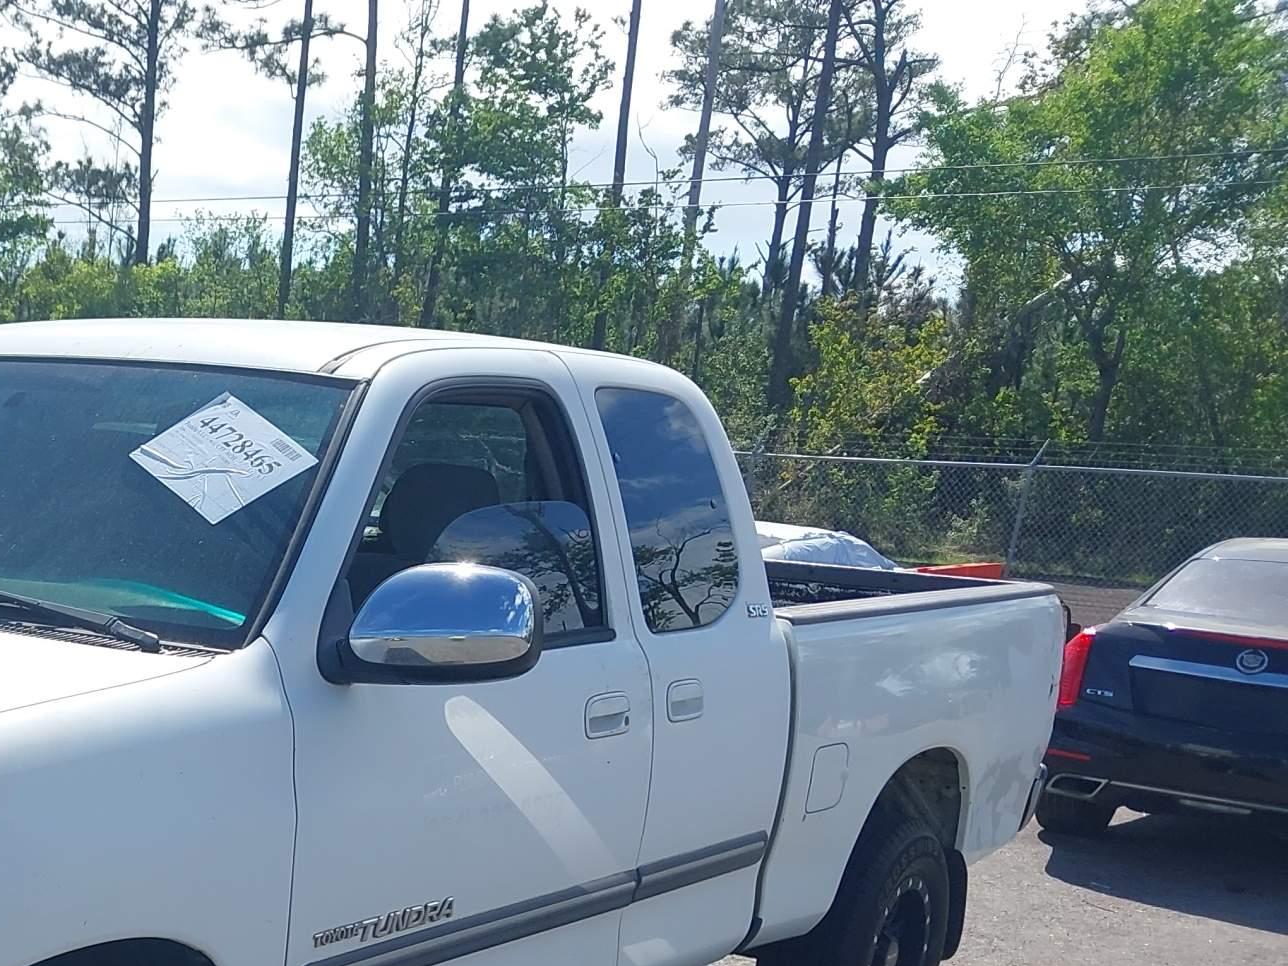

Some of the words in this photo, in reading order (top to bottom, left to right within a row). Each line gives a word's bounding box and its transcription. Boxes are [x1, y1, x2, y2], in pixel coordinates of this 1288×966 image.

[199, 416, 282, 475] 44728465
[1086, 688, 1114, 697] CTS
[313, 923, 359, 948] TOYOTA
[359, 896, 454, 942] TUNDRA
